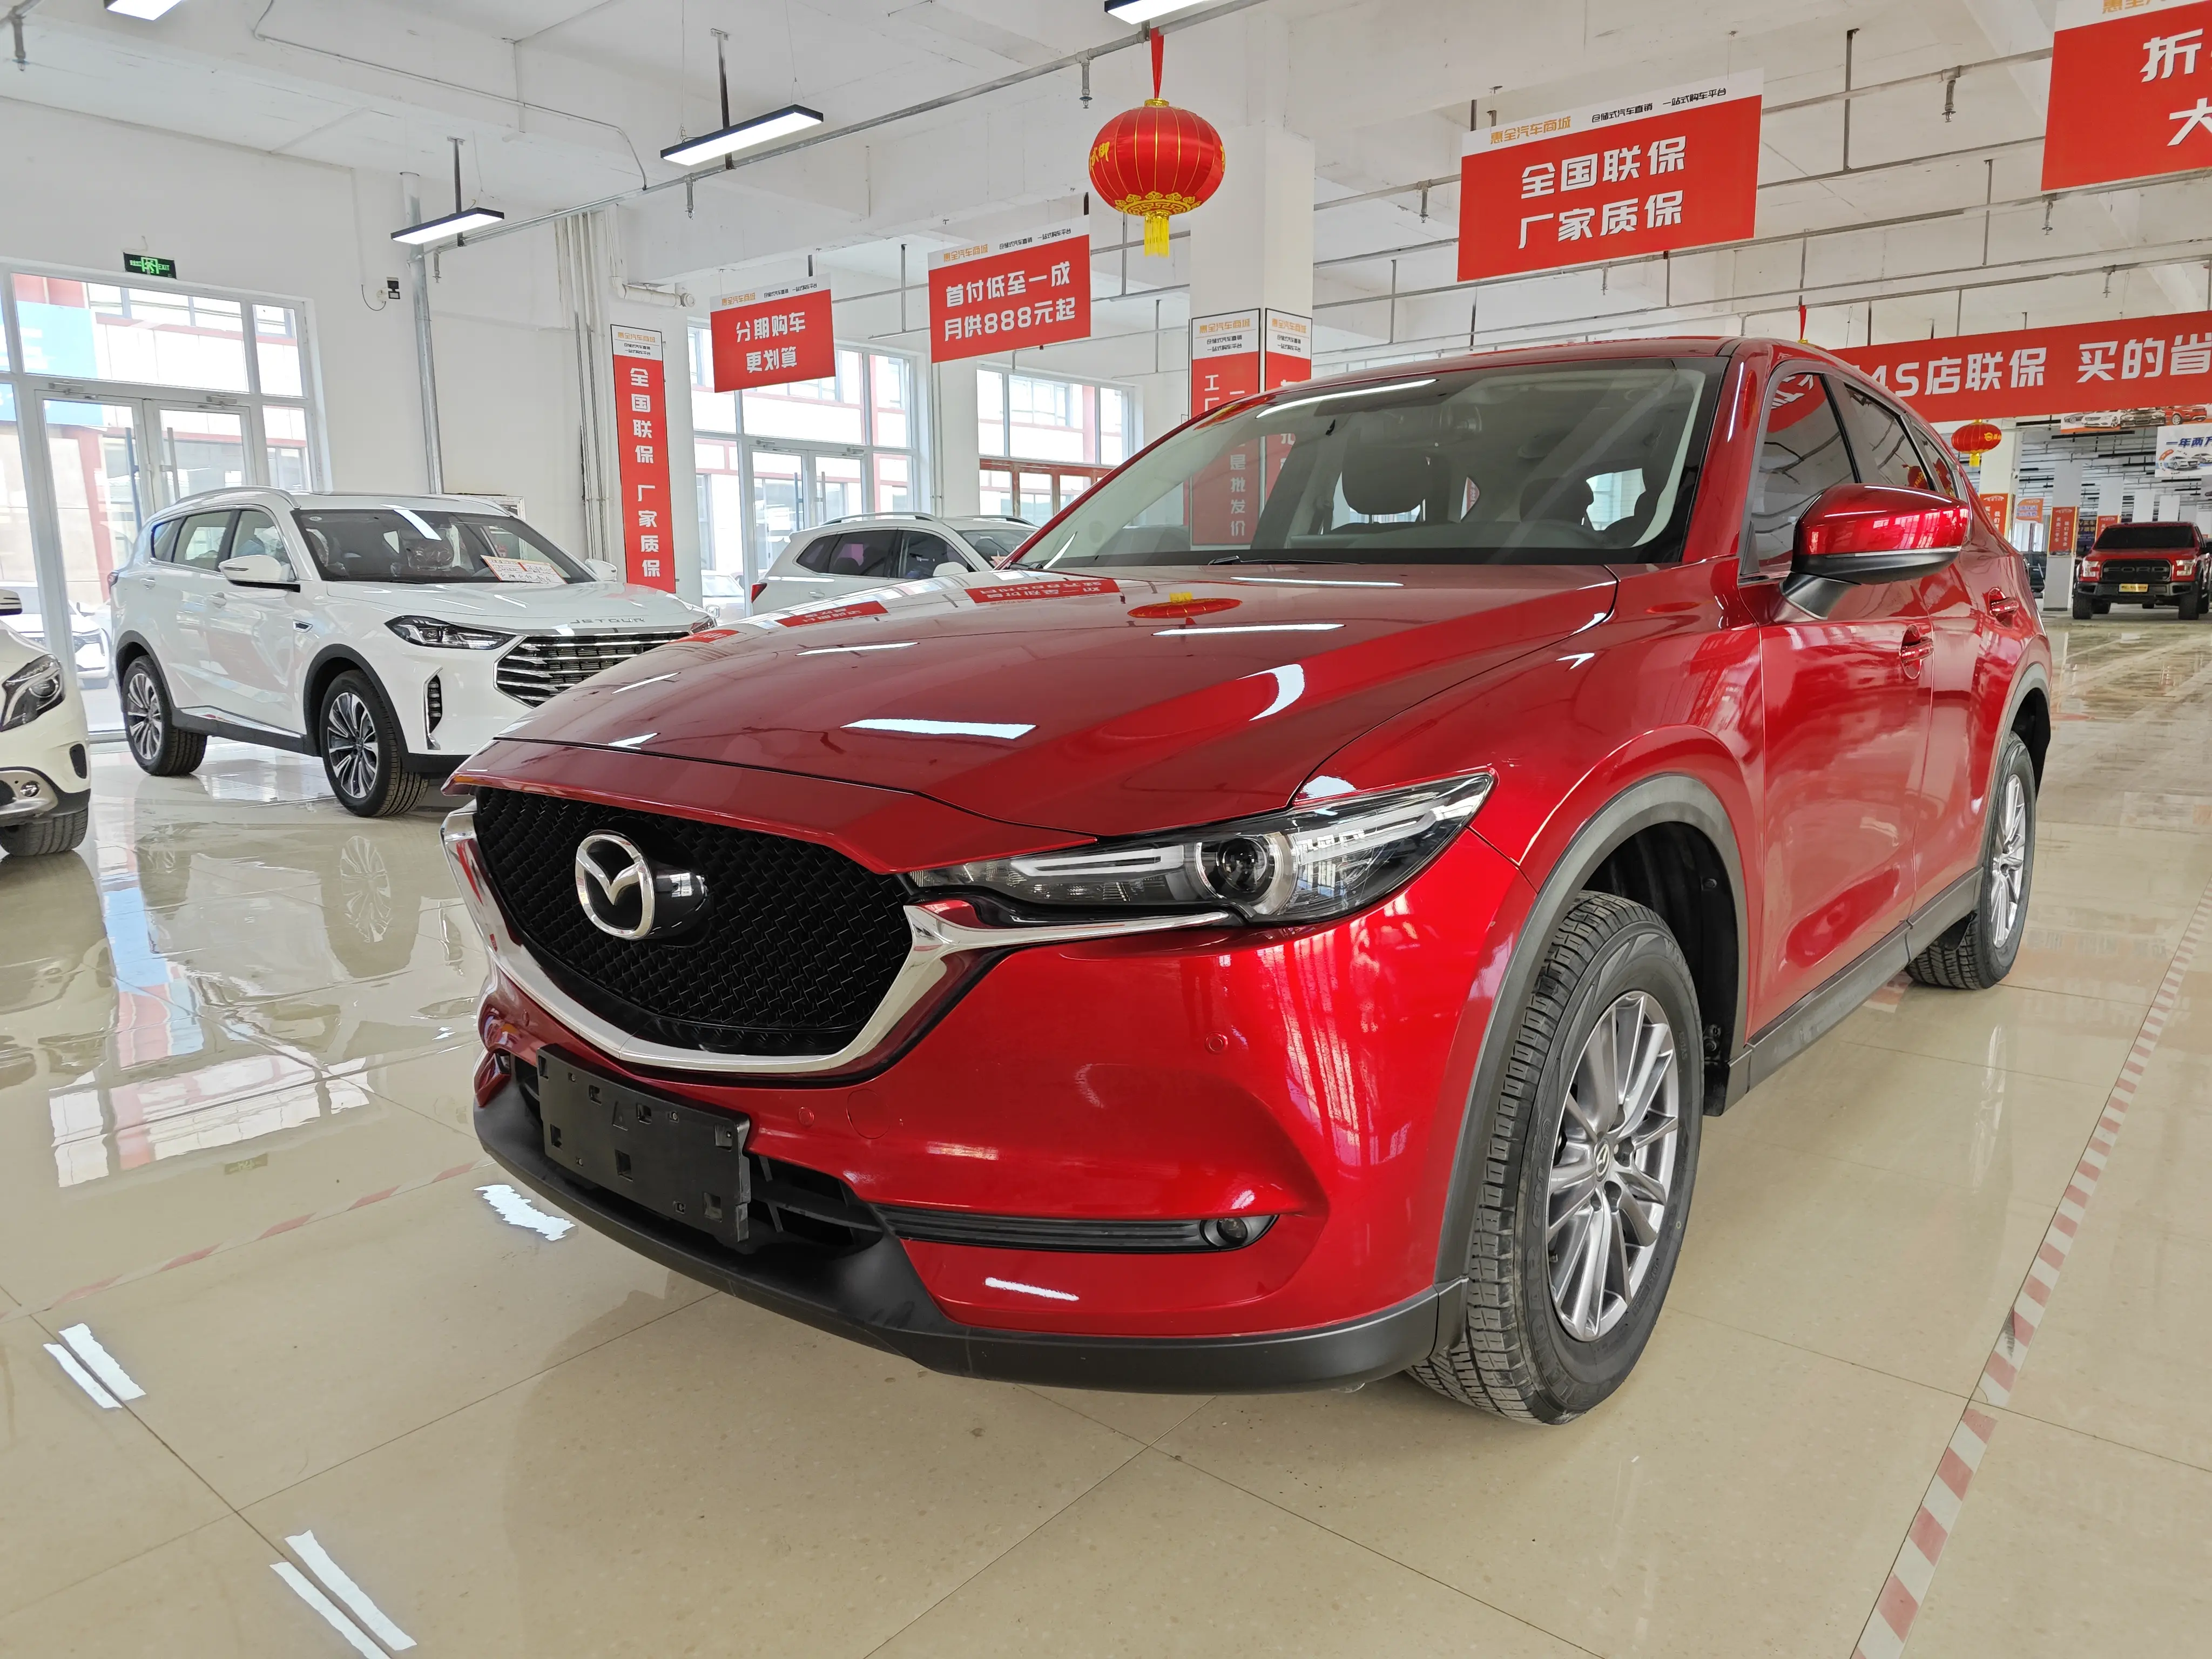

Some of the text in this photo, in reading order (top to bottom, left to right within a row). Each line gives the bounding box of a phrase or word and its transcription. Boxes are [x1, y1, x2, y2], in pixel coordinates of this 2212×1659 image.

[2139, 28, 2212, 83] 折
[1489, 87, 1727, 144] 惠全汽车商城 仓储式汽车直销 一站式购车平台
[1521, 135, 1687, 199] 全国联保
[1518, 190, 1684, 249] 厂家质保
[943, 244, 988, 262] 惠全汽车商城
[946, 260, 1070, 308] 首付低至一成
[736, 311, 806, 343] 分期购车
[945, 297, 1075, 342] 月供888元起
[1199, 318, 1250, 334] 惠全汽车商城
[746, 346, 798, 373] 更划算
[1854, 347, 2047, 398] 4S店联保
[630, 367, 660, 578] 全国联保 厂家质保
